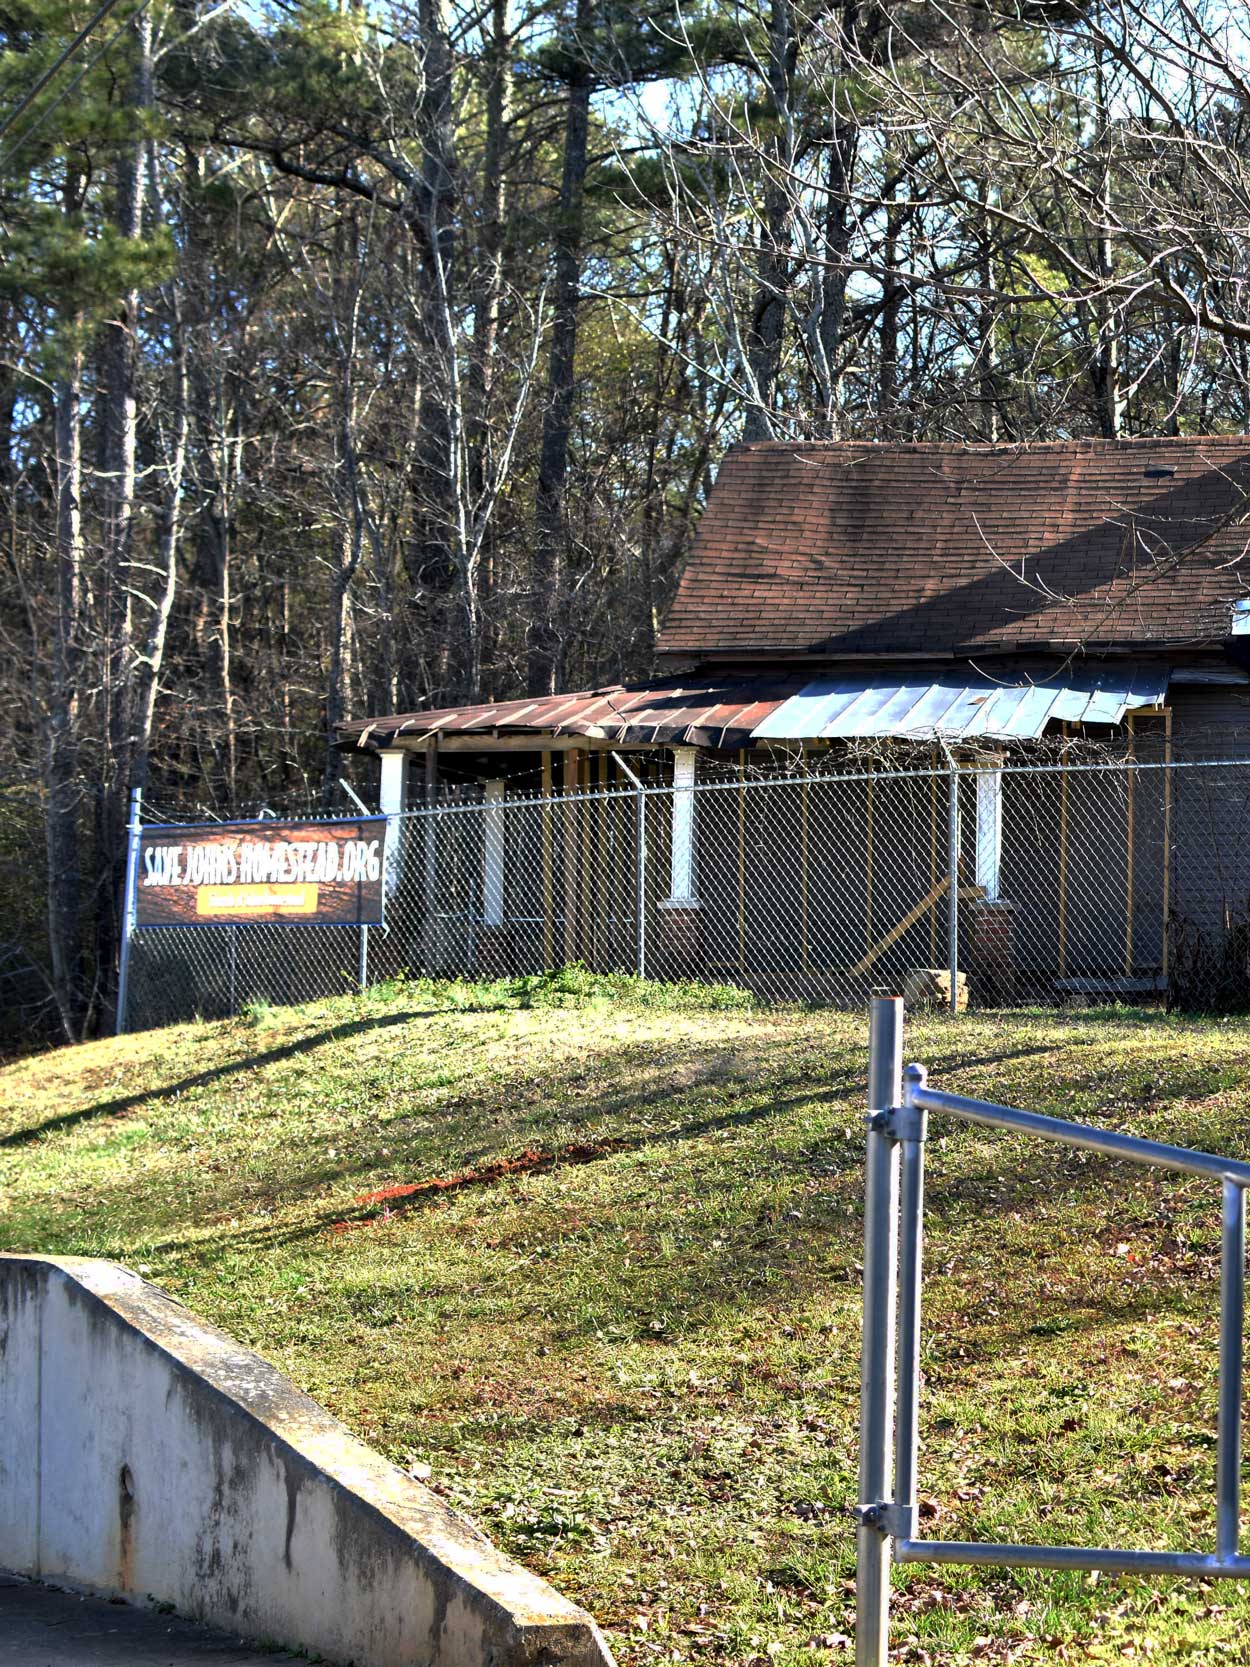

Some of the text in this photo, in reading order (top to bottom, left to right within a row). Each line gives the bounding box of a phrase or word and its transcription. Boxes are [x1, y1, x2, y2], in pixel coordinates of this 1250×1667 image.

[144, 840, 380, 887] SAVE JOHNS HOMESTEAD.ORG
